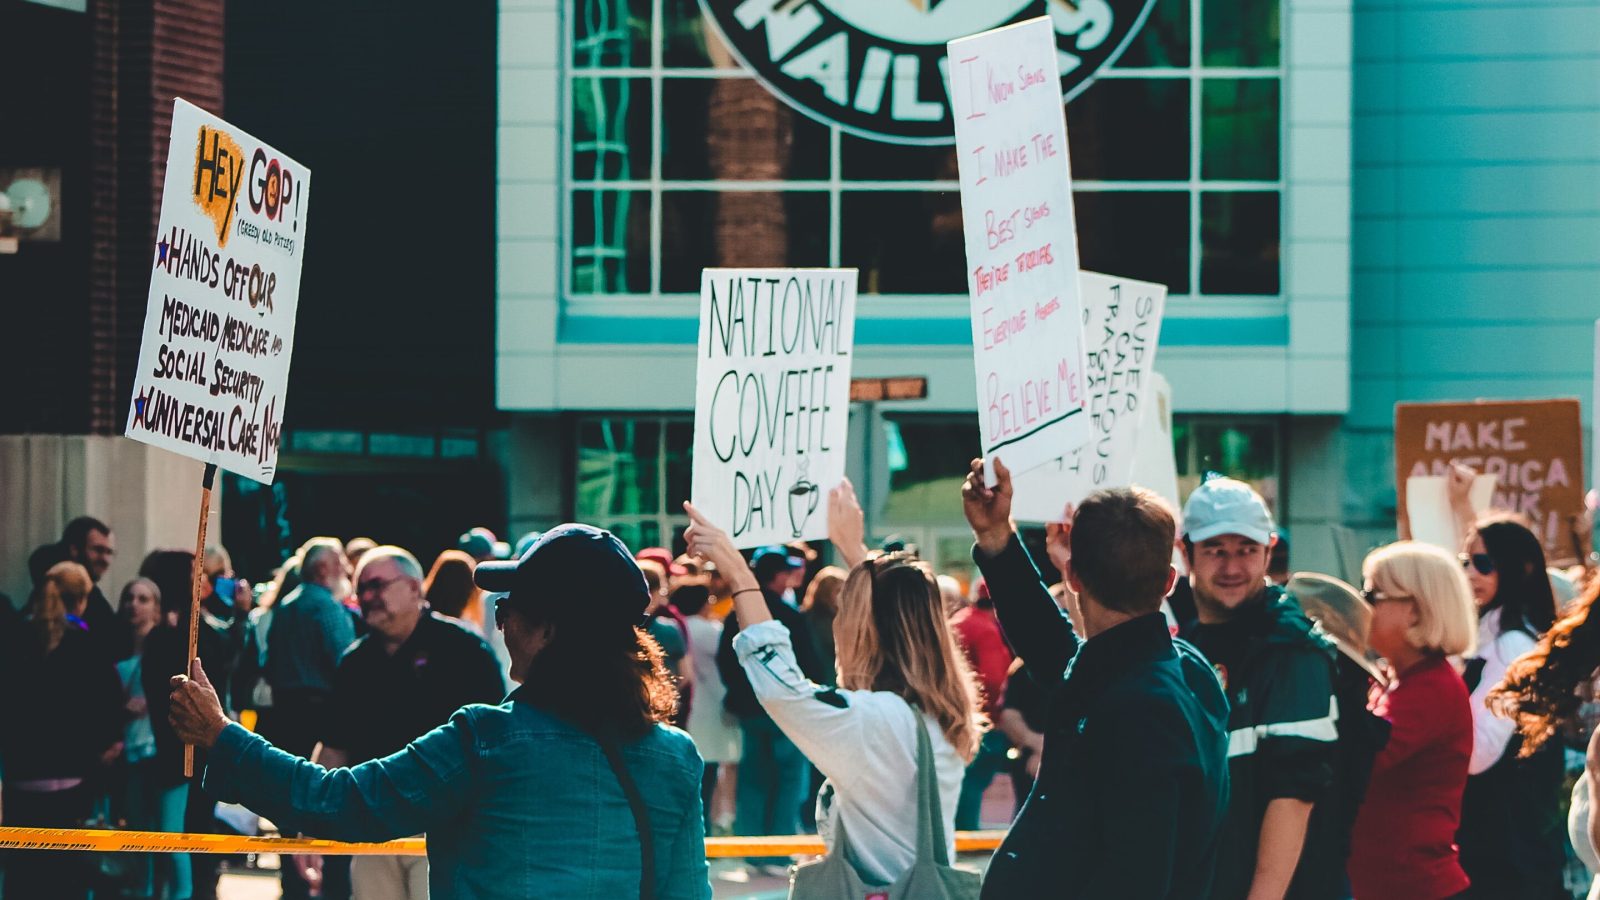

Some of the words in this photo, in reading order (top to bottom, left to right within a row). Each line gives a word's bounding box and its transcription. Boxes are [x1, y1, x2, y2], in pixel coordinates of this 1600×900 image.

[734, 0, 1113, 121] NAILS
[960, 55, 986, 119] I
[248, 147, 300, 233] GOP!
[973, 145, 987, 185] I
[994, 145, 1027, 177] MAKE
[1032, 133, 1057, 163] THE
[262, 228, 273, 245] OLD
[985, 208, 1021, 250] BEST
[167, 226, 220, 289] HANDS
[223, 257, 250, 301] OFF
[248, 263, 276, 315] OUR
[708, 277, 848, 358] NATIONAL
[153, 343, 207, 387] SOCIAL
[210, 359, 264, 424] SECURITY
[1122, 296, 1152, 416] SUPER
[144, 385, 226, 452] UNIVERSAL
[228, 404, 260, 458] CARE
[710, 365, 834, 463] COVFEFE
[987, 371, 1053, 442] BELIEVE
[1092, 332, 1130, 485] CALLOUS
[1425, 418, 1528, 453] MAKE
[734, 465, 782, 538] DAY
[1411, 456, 1569, 491] ARICA
